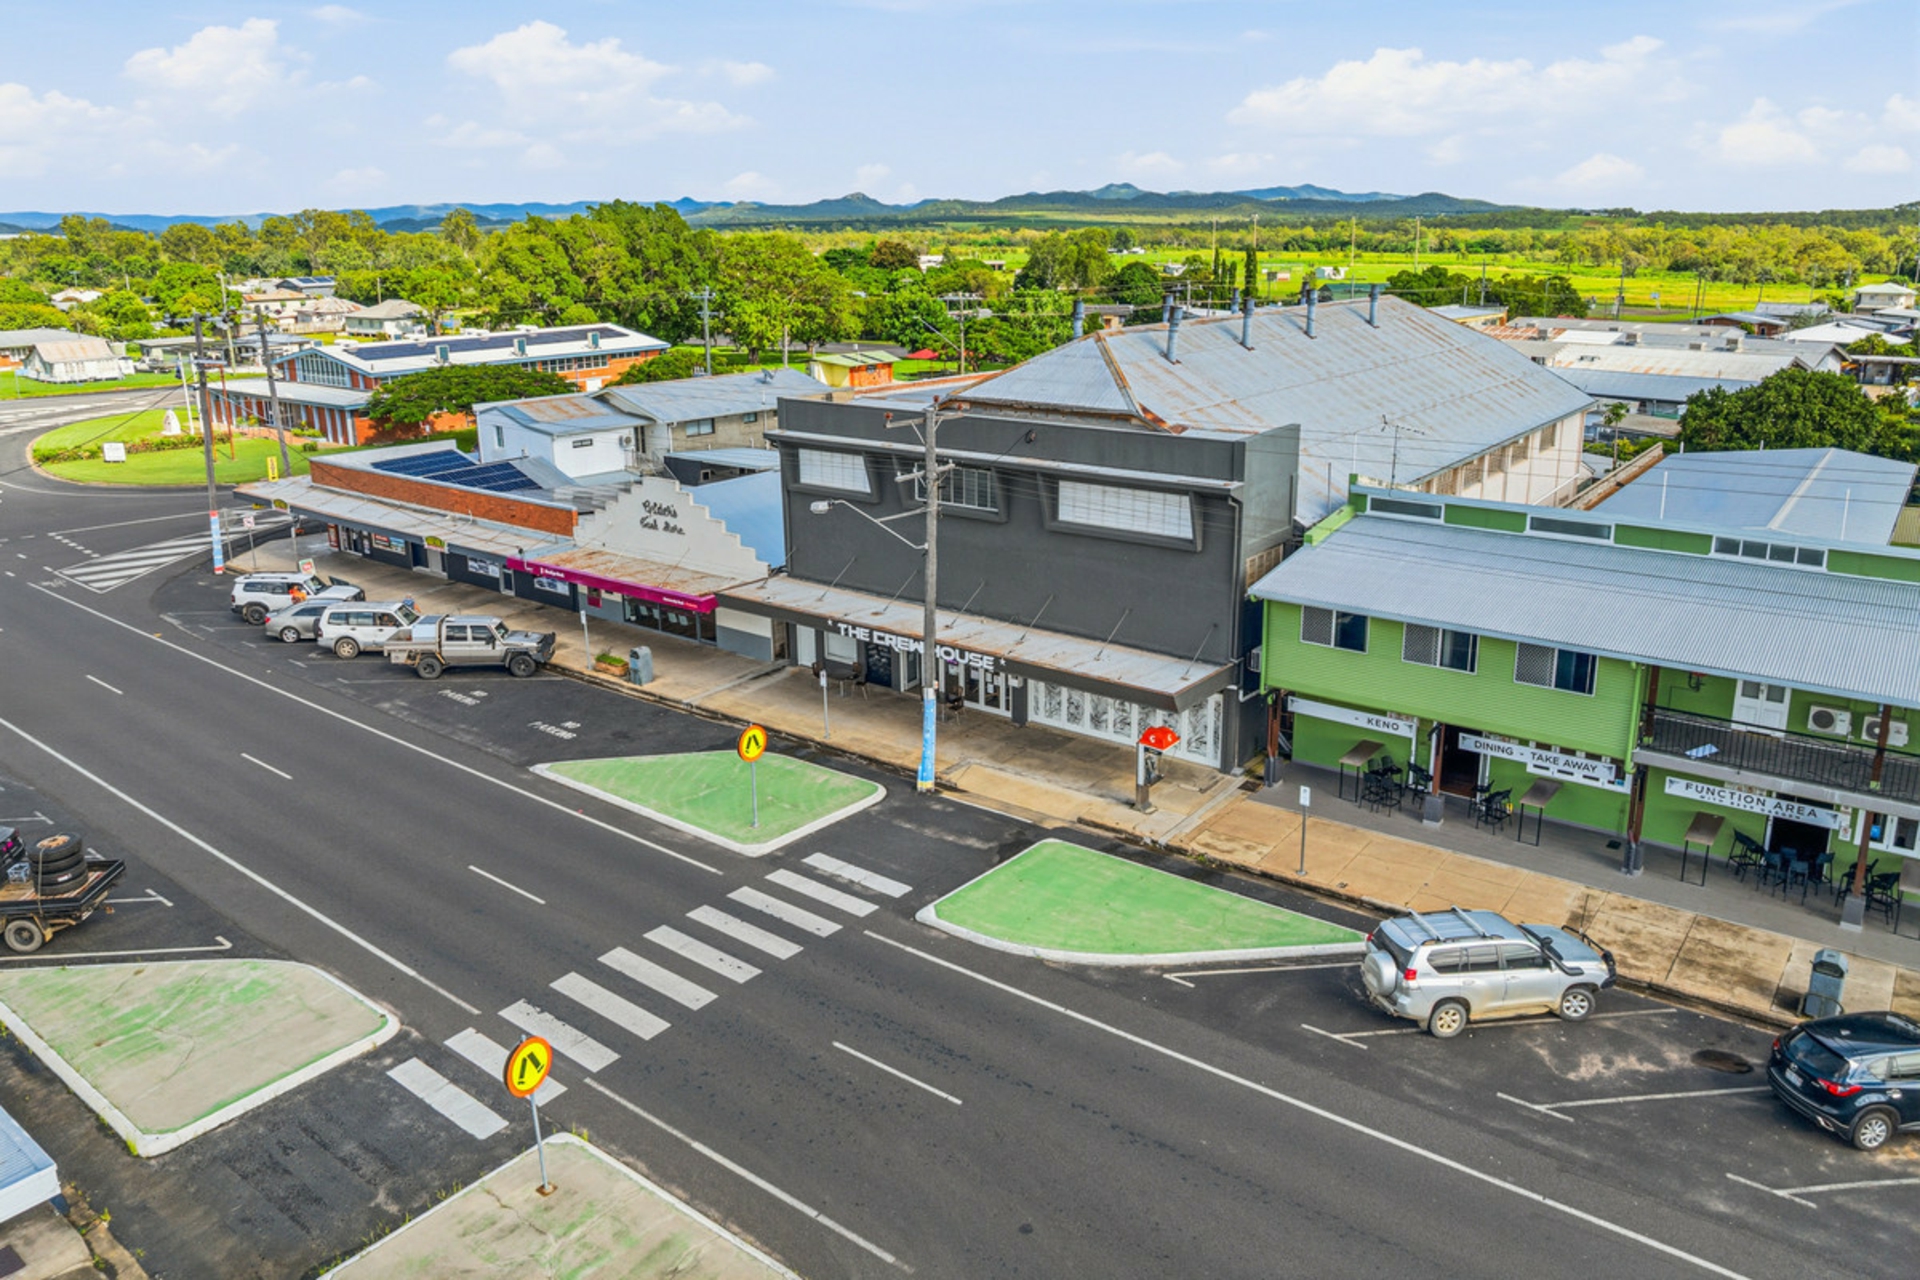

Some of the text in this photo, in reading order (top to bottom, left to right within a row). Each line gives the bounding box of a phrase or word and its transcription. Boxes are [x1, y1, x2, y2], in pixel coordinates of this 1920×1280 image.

[837, 623, 870, 641] THE
[873, 630, 925, 654] CREW
[1366, 717, 1400, 731] KENO
[1474, 740, 1514, 756] DINING
[1530, 751, 1560, 766] TAKE
[1563, 759, 1598, 773] AWAY
[1685, 782, 1818, 818] FUNCTION AREA
